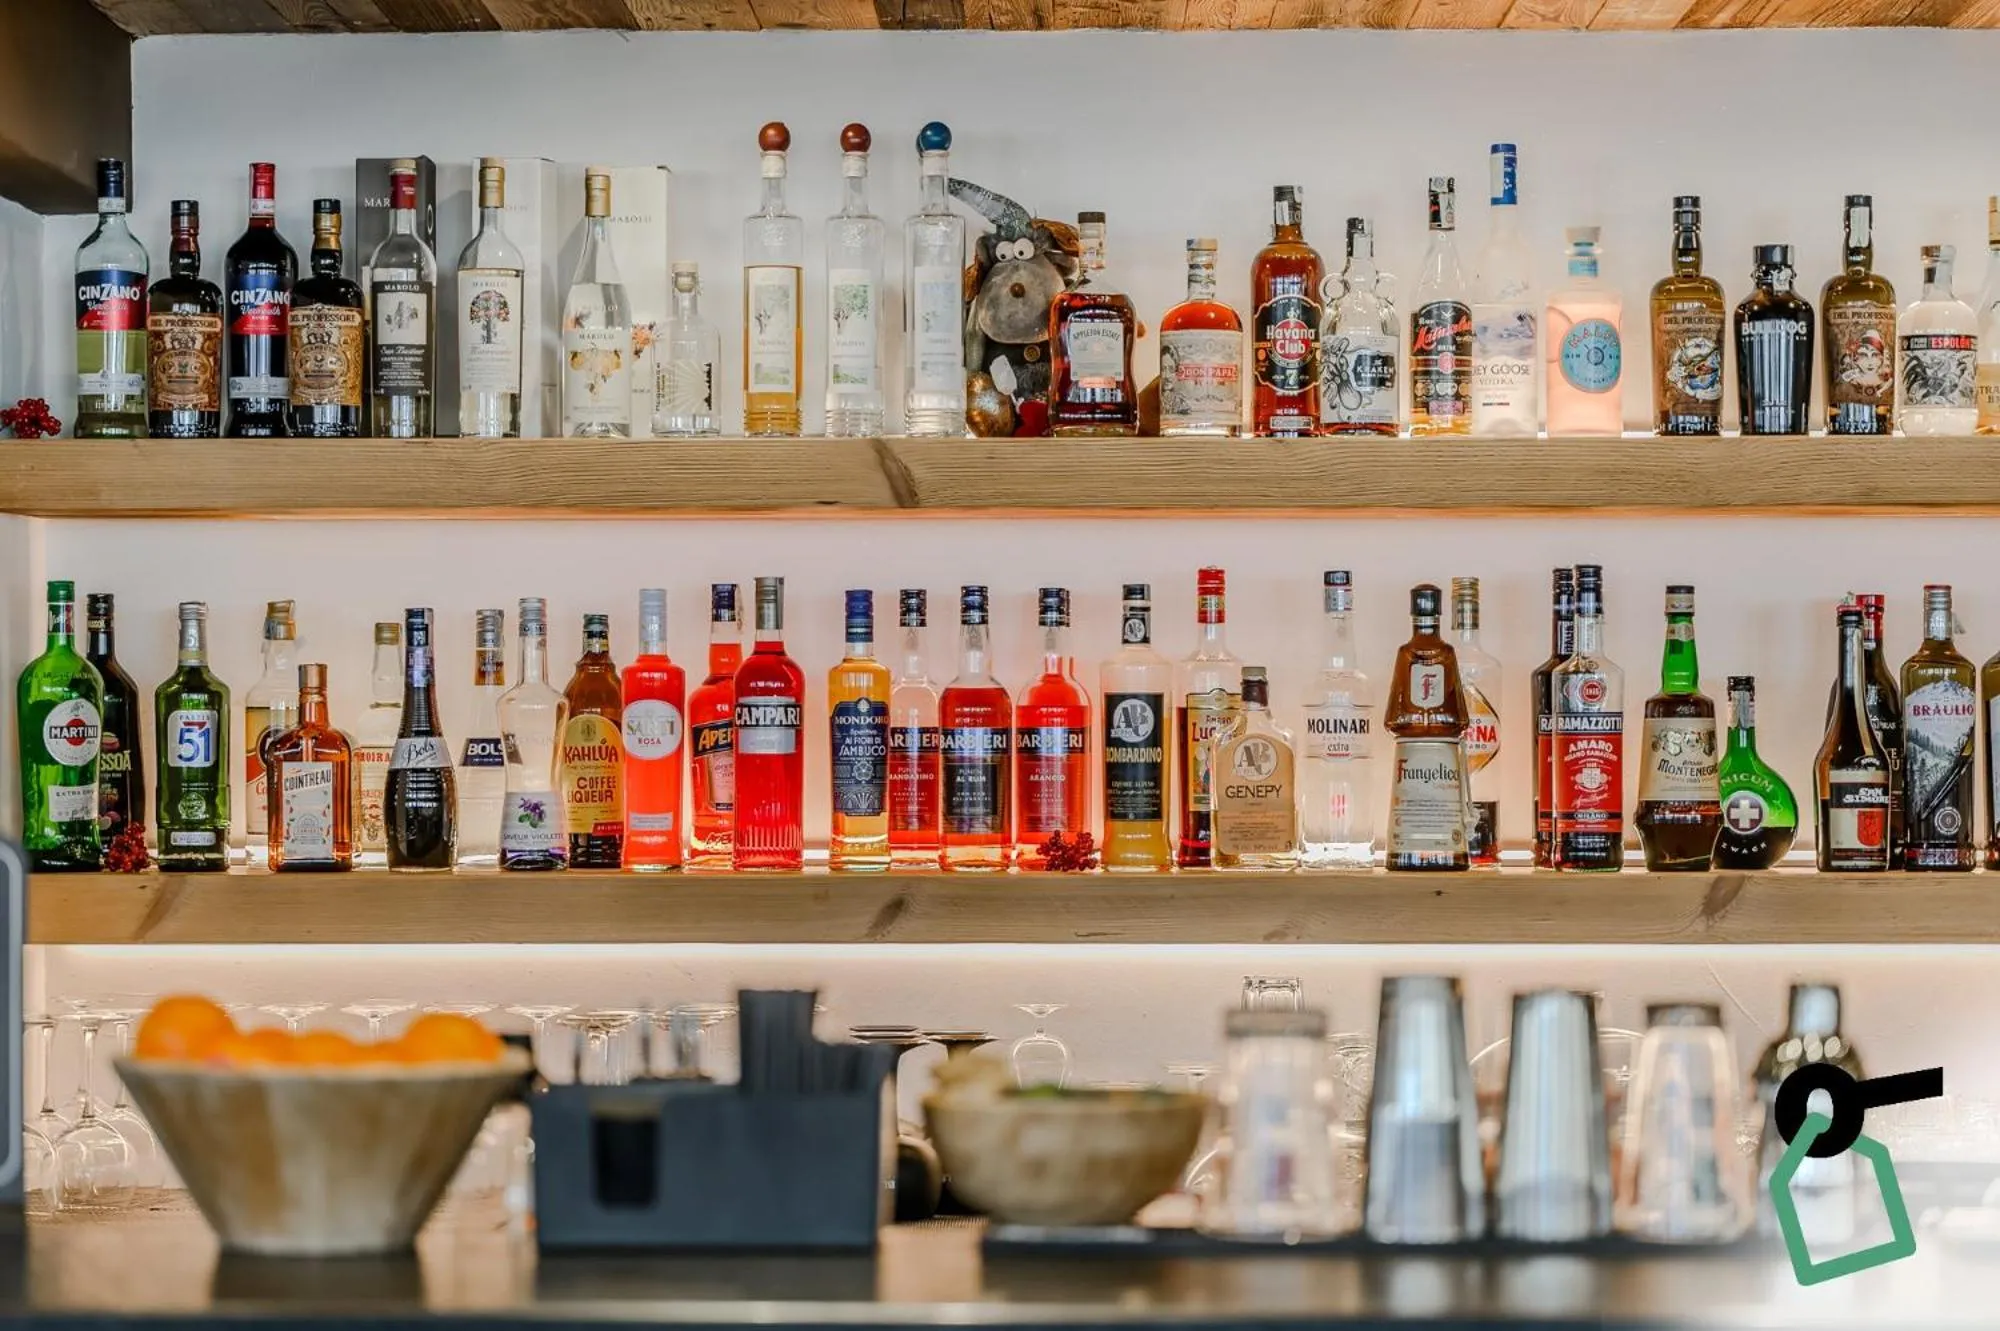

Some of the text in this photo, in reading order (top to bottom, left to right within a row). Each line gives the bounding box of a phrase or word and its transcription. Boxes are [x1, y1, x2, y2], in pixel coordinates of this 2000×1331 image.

[365, 198, 391, 208] MAR
[79, 283, 141, 301] CINZANO
[384, 283, 420, 291] MAROLO
[231, 288, 289, 306] CINZANO
[1266, 325, 1316, 339] Havana
[1742, 321, 1807, 335] BULLDOG
[1276, 339, 1306, 354] Club
[1490, 364, 1530, 375] GOOSE
[736, 706, 800, 725] CAMPARI
[1307, 718, 1370, 734] MOLINARI
[1558, 716, 1622, 731] RAMAZZOTTI
[51, 726, 98, 738] MARTINI
[177, 728, 211, 762] 51
[638, 737, 661, 745] ROSA
[940, 734, 1007, 749] BARBIERI
[1017, 734, 1083, 748] BARBIERI
[1569, 740, 1613, 753] AMARO
[564, 738, 619, 763] KAHLÚA
[840, 745, 886, 756] SAMBUCO
[1396, 758, 1460, 784] Frangelico
[284, 769, 332, 791] COINTREAU
[577, 776, 616, 789] COFFEE
[1721, 772, 1774, 793] NICUM
[568, 789, 614, 804] LIQUEUR
[1224, 784, 1282, 799] GENEPY
[1858, 787, 1884, 797] SAN
